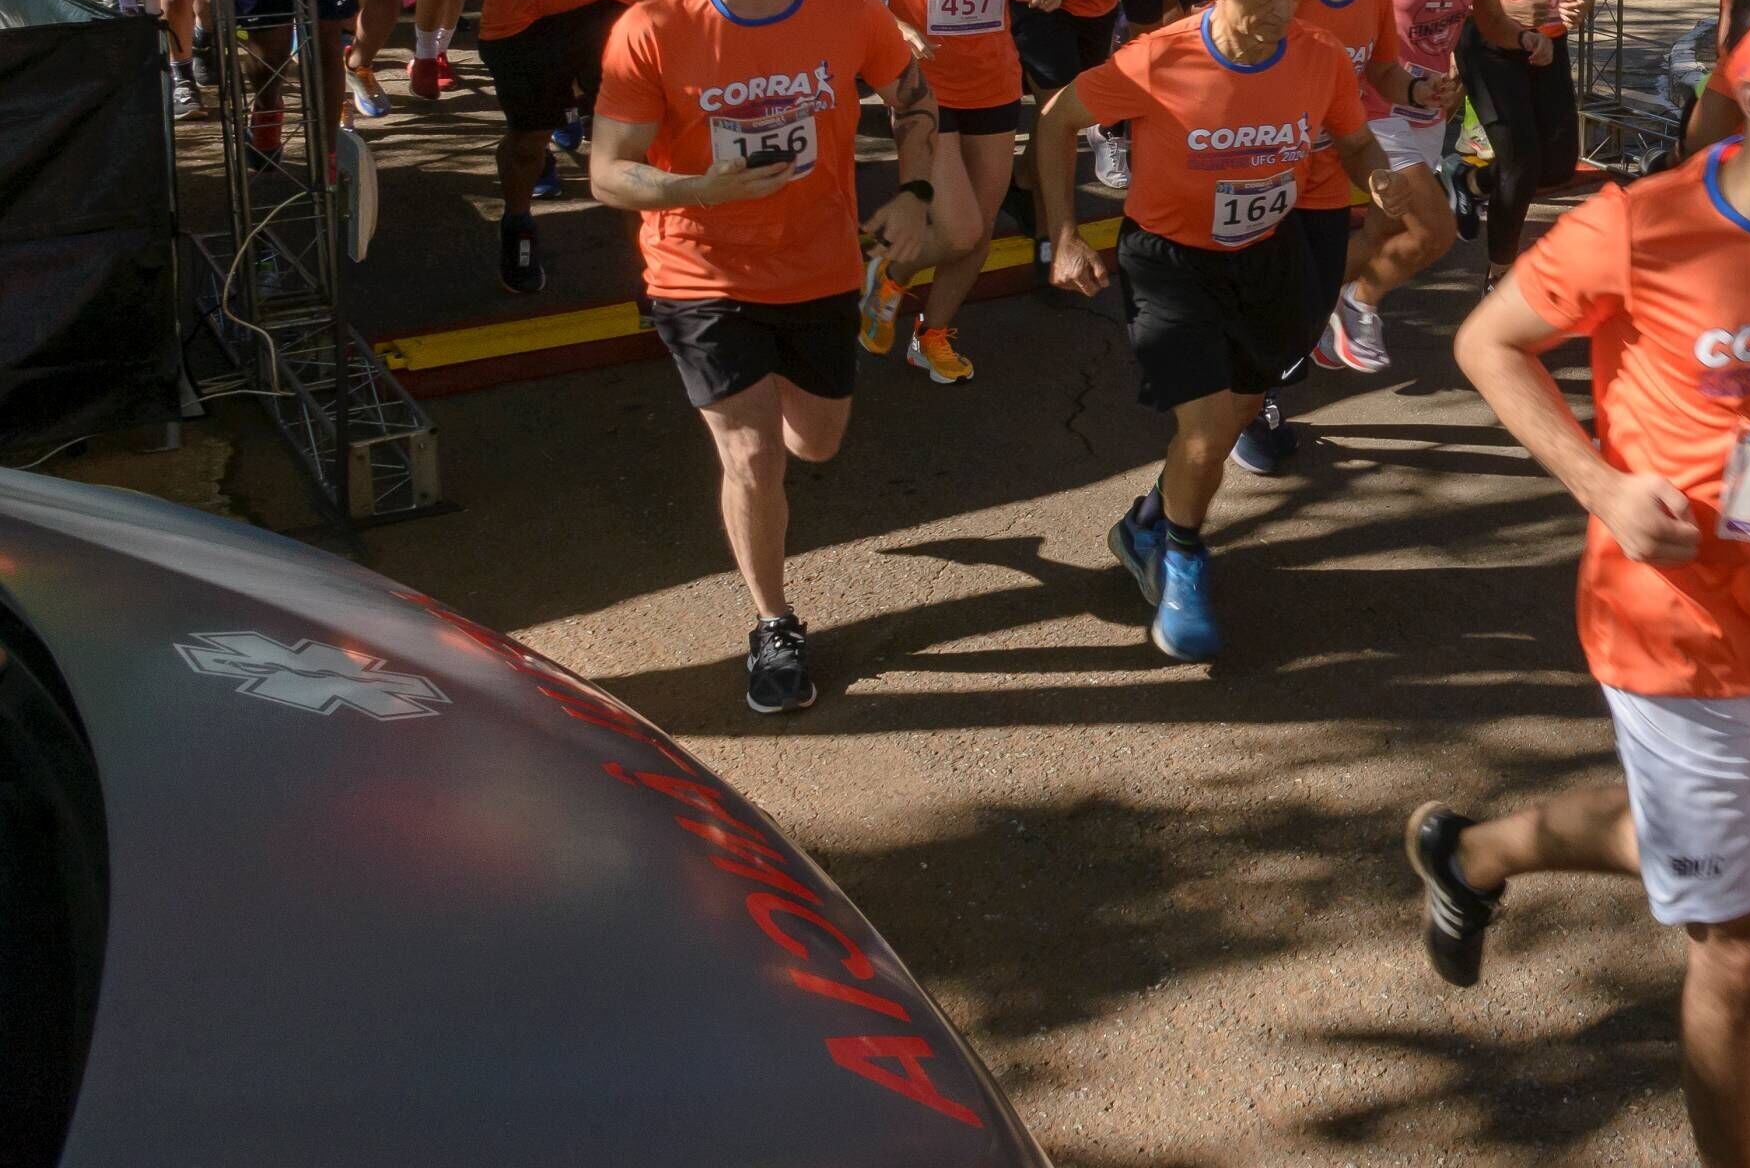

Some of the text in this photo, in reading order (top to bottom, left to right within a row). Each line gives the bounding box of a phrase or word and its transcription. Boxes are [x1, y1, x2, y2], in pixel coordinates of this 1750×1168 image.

[699, 72, 812, 112] CORRA
[733, 126, 808, 158] 156
[1187, 123, 1294, 150] CORRA
[1251, 155, 1276, 167] UFG
[1223, 190, 1288, 226] 164
